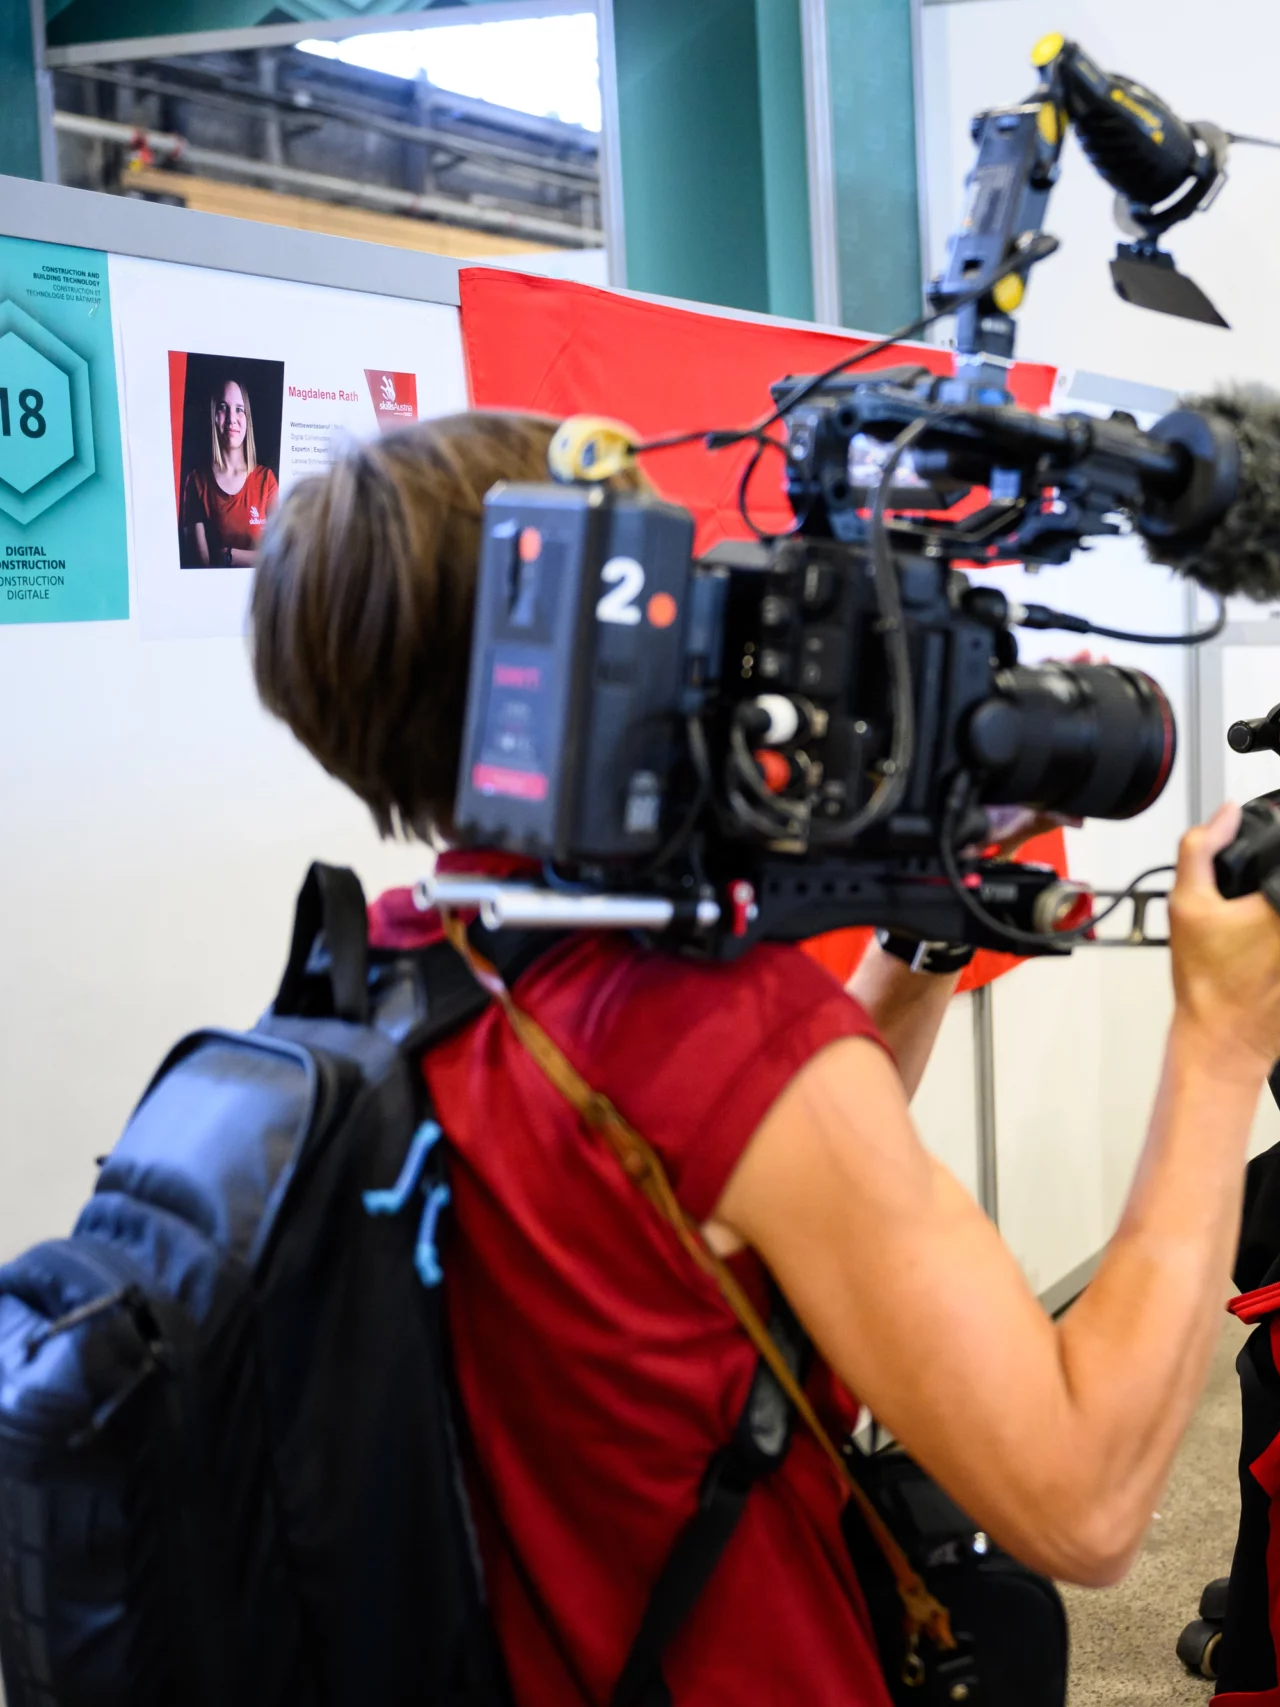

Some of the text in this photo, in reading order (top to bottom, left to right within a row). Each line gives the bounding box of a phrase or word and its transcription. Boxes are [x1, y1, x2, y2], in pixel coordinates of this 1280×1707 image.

[42, 265, 86, 277] CONSTRUCTION
[33, 272, 100, 287] BUILDING TECHNOLOGY
[26, 289, 65, 301] TECHNOLOGIE
[53, 284, 93, 295] CONSTRUCTION
[288, 386, 359, 402] Magdalena Rath
[0, 387, 46, 439] 18
[6, 546, 47, 557] DIGITAL
[7, 589, 50, 600] DIGITALE
[595, 556, 646, 626] 2
